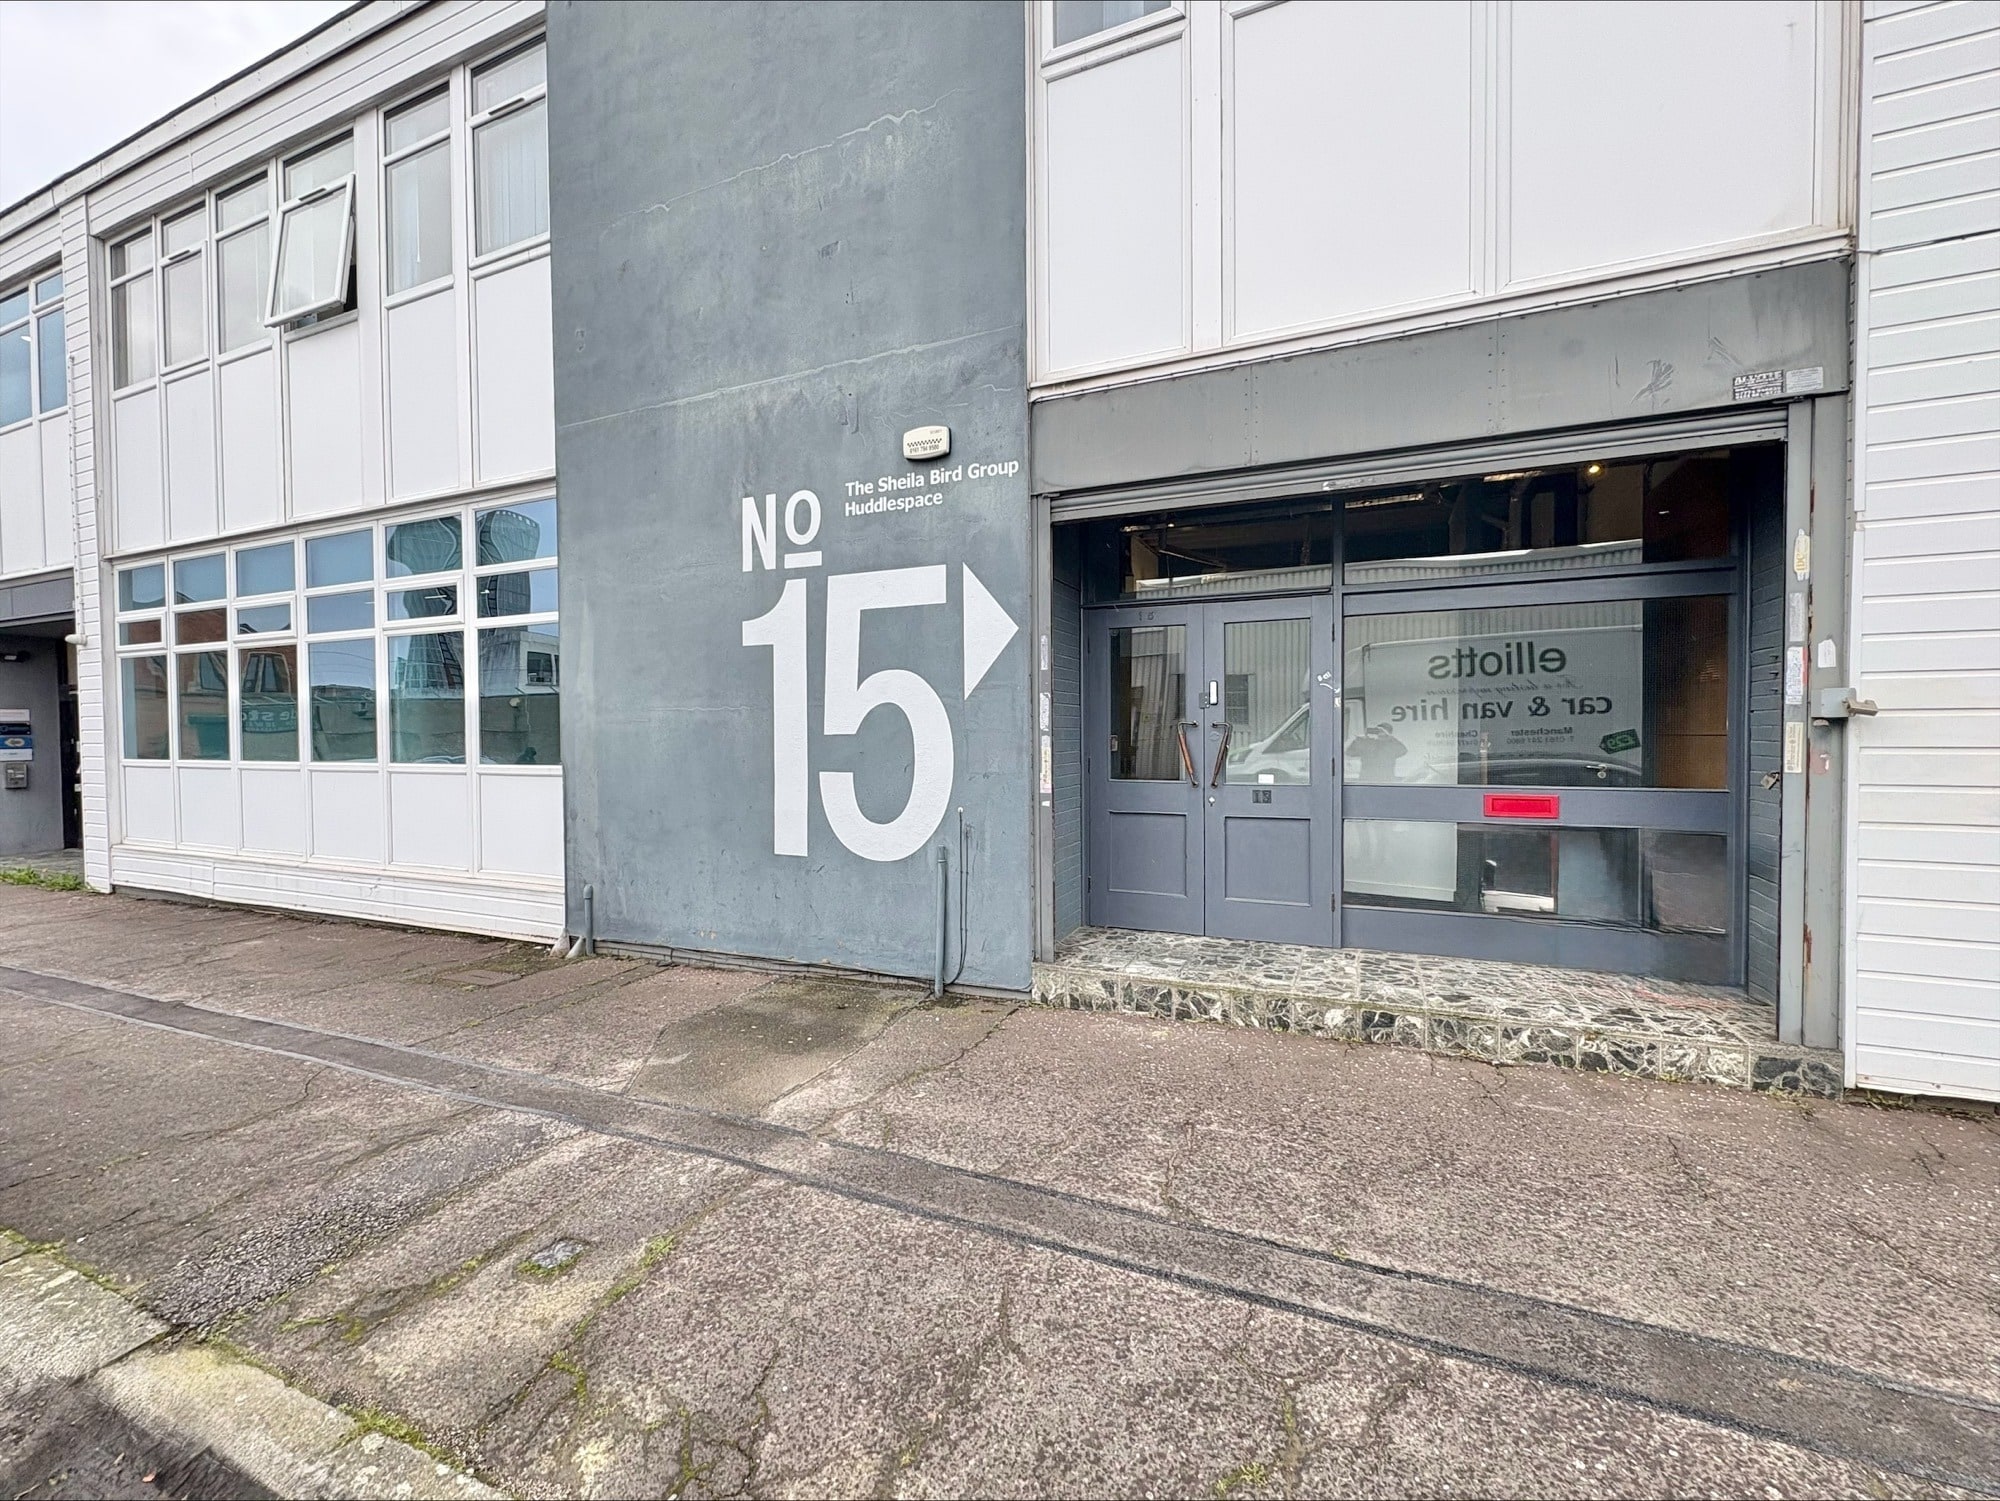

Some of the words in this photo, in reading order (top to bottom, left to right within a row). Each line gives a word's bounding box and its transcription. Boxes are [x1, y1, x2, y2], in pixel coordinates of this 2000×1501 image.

[845, 480, 874, 497] The
[877, 473, 925, 493] Sheila
[930, 466, 962, 485] Bird
[967, 460, 1019, 480] Group
[845, 491, 943, 517] Huddlespace
[742, 564, 954, 862] 15
